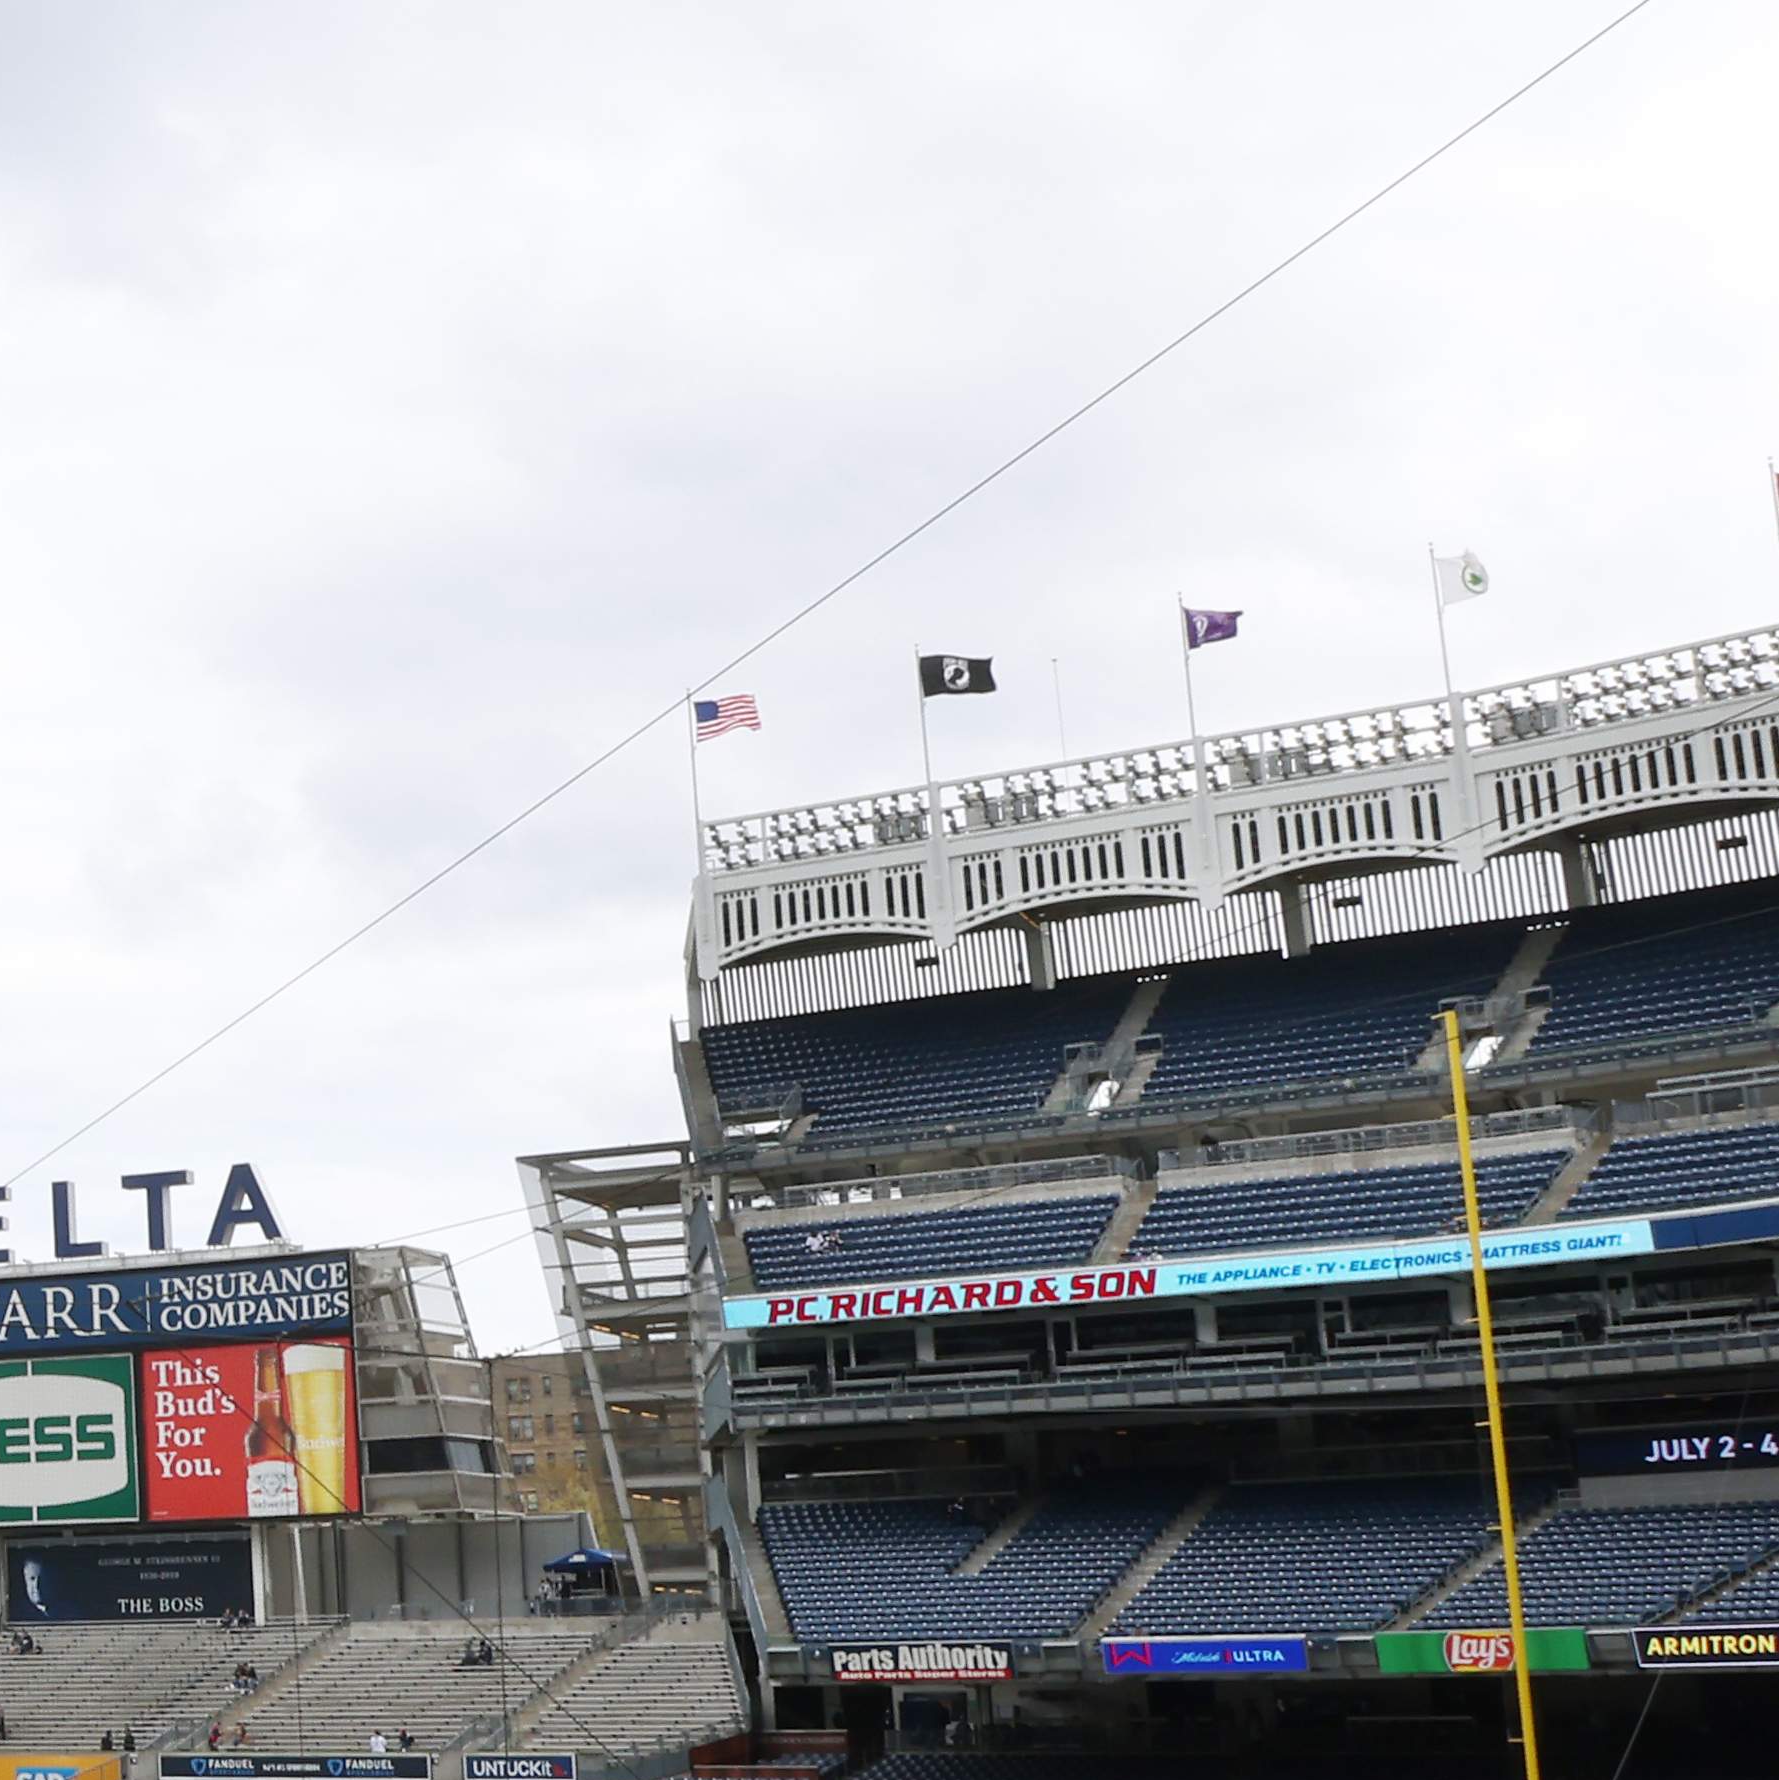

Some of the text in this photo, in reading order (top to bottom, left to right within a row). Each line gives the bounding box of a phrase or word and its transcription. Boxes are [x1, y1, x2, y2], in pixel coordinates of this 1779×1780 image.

[1177, 1233, 1623, 1286] THE APPLIANCE TV ELECTRONICS GIANT!
[159, 1260, 350, 1304] INSURANCE
[767, 1269, 1158, 1323] P.C. RICHARD & SON
[159, 1289, 351, 1333] COMPANIES
[151, 1358, 221, 1388] This
[154, 1388, 237, 1419] Bud's
[155, 1421, 207, 1450] For
[1644, 1433, 1779, 1463] JULY 2 4
[157, 1450, 222, 1479] You.
[117, 1596, 205, 1614] THE BOSS
[832, 1642, 1009, 1673] Parts Authority
[1232, 1650, 1286, 1663] ULTRA
[1449, 1633, 1511, 1670] Lay's
[1646, 1634, 1775, 1657] ARMITRON
[208, 1758, 394, 1770] FANDUEL FANDUEL
[472, 1760, 553, 1777] UNTUCKit
